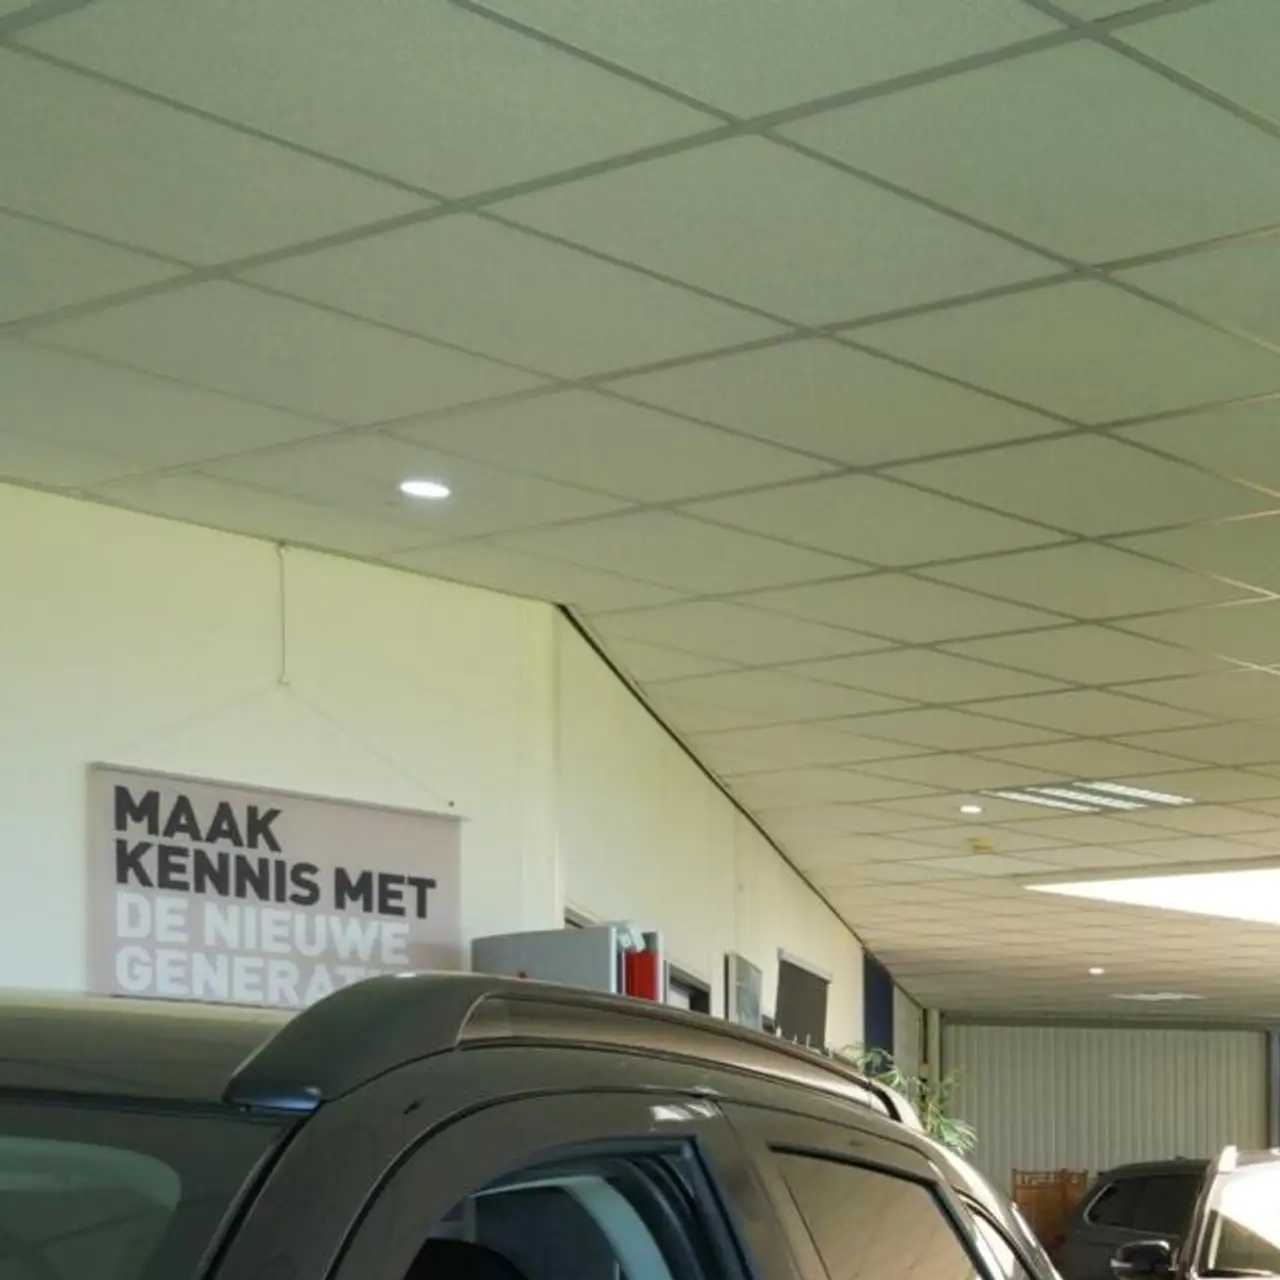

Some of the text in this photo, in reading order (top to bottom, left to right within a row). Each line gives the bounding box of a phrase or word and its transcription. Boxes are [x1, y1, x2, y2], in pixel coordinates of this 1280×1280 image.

[114, 785, 283, 853] MAAK
[115, 838, 437, 919] KENNIS MET
[116, 890, 410, 965] DE NIEUWE
